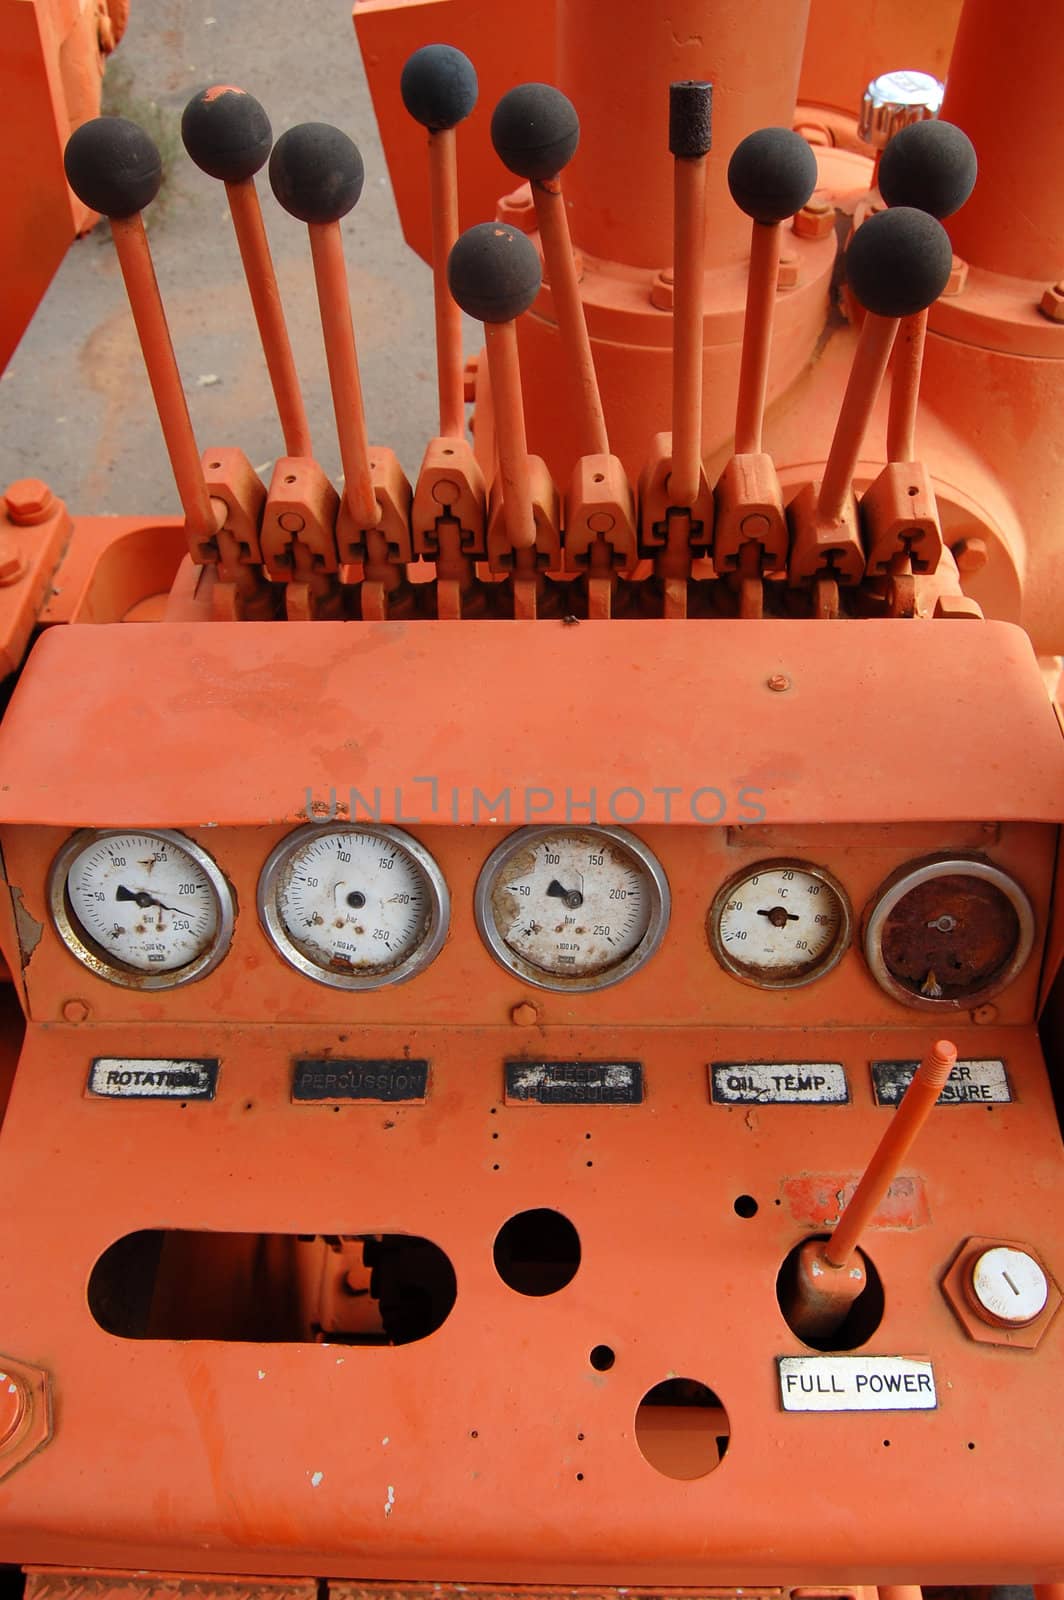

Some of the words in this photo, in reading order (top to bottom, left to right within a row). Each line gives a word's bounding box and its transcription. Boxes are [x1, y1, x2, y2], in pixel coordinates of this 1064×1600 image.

[111, 857, 127, 867] 100
[153, 852, 168, 863] 150
[336, 851, 351, 863] 100
[544, 854, 560, 865] 100
[588, 854, 604, 866] 150
[378, 857, 394, 870] 150
[752, 877, 759, 886] 0
[781, 871, 794, 881] 20
[307, 877, 318, 888] 50
[178, 884, 196, 895] 200
[519, 886, 531, 896] 50
[609, 889, 627, 900] 200
[807, 885, 820, 895] 40
[94, 892, 106, 902] 50
[392, 893, 410, 905] 200
[564, 914, 576, 925] bar
[172, 920, 190, 931] 250
[593, 925, 610, 936] 250
[372, 928, 390, 941] 250
[795, 941, 808, 950] 80
[301, 1073, 423, 1090] PERCUSSION
[726, 1075, 762, 1092] OIL
[786, 1374, 845, 1393] FULL
[855, 1373, 932, 1393] POWER
